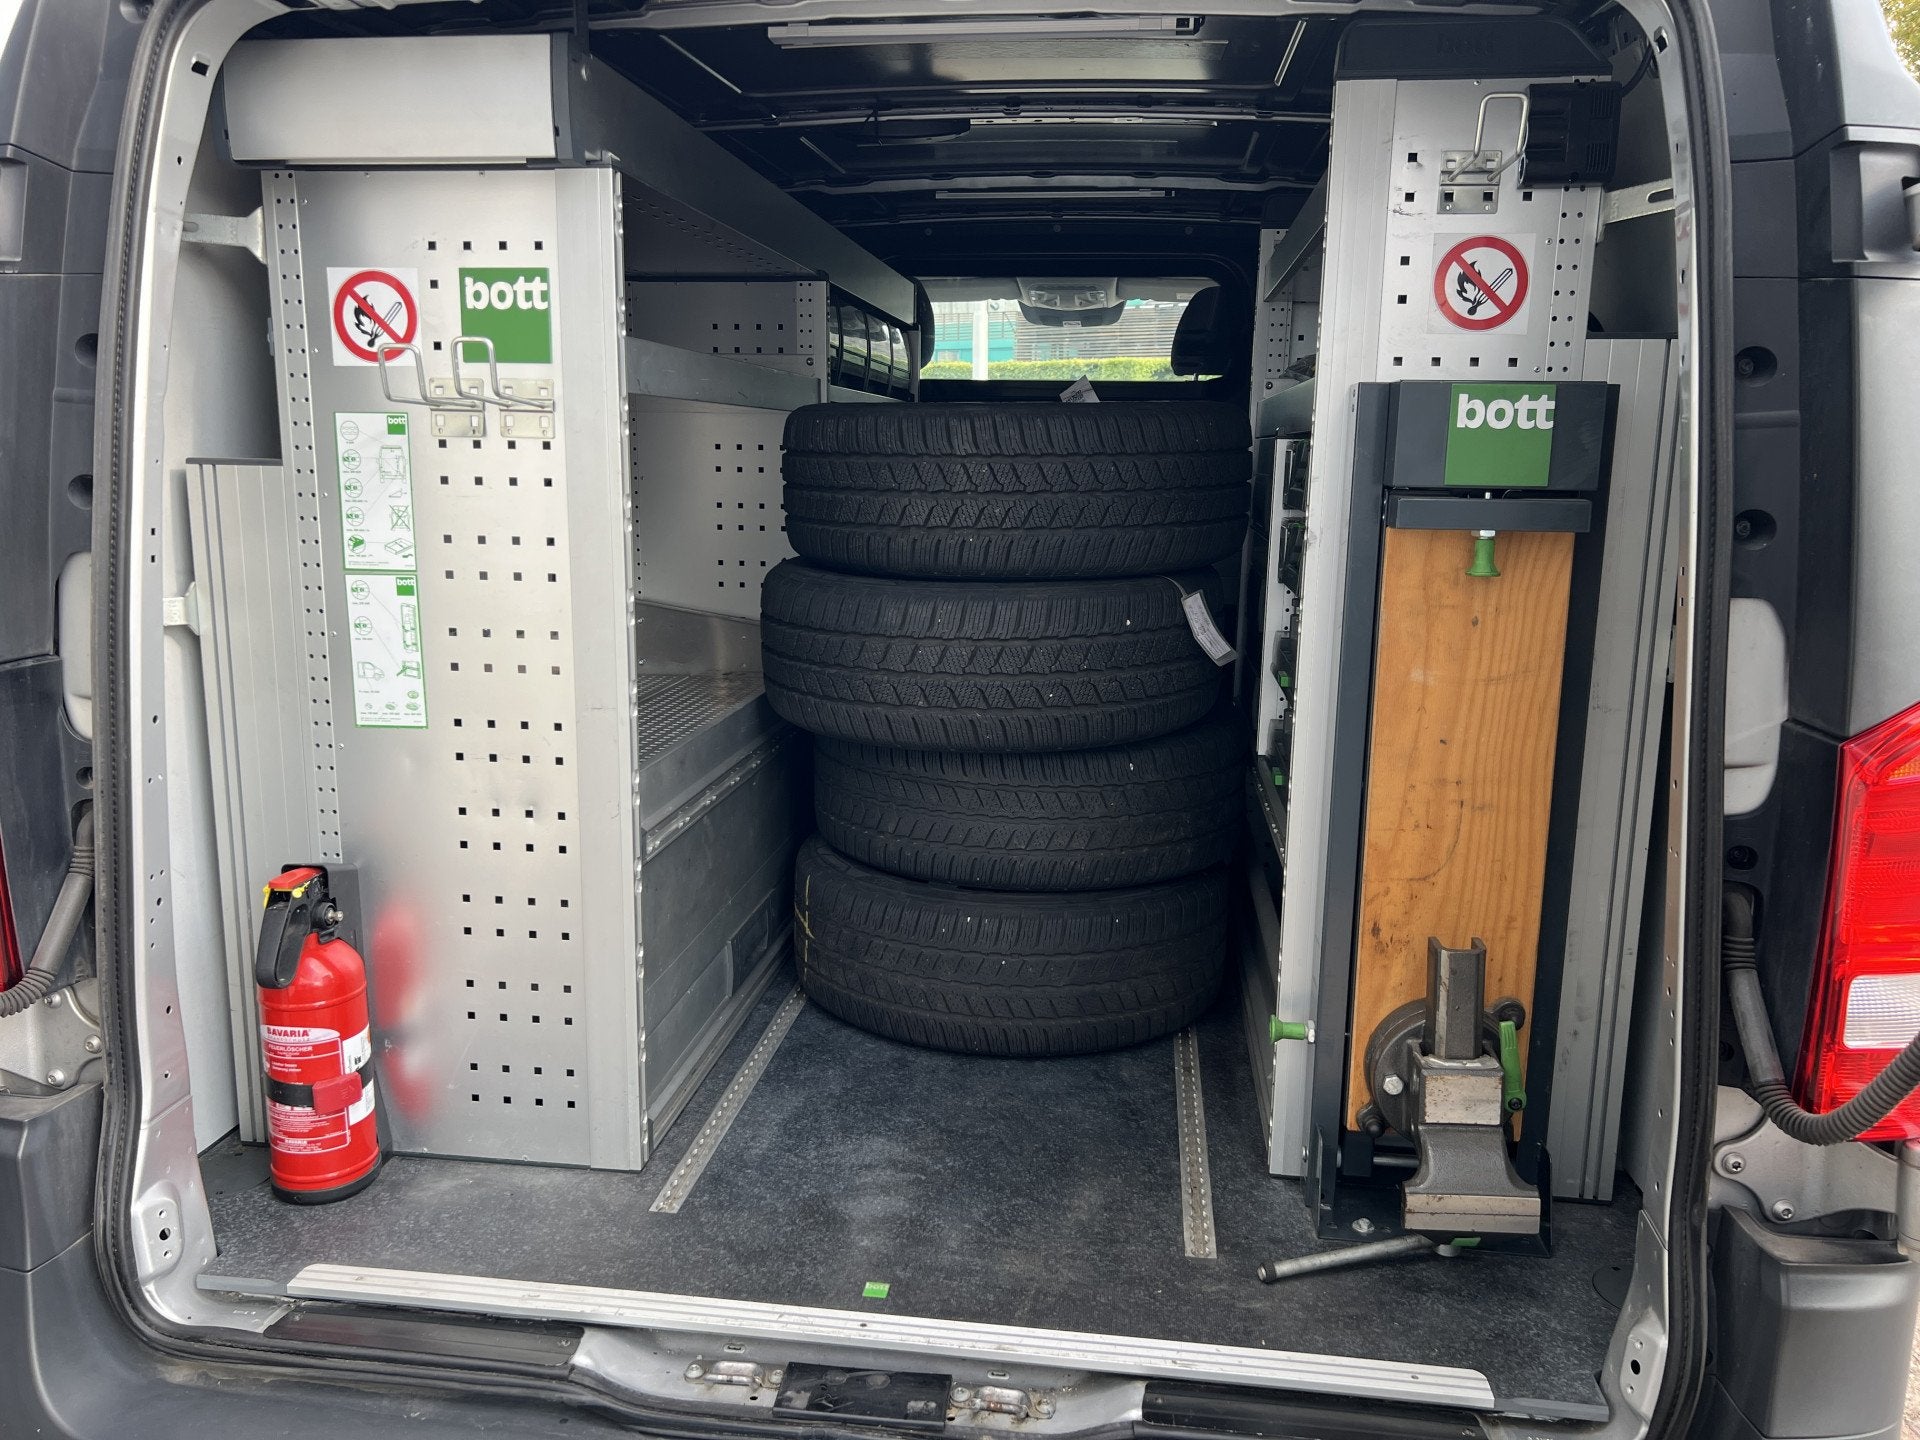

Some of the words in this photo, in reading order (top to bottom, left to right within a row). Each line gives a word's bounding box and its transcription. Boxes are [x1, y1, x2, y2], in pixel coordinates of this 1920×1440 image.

[464, 276, 548, 310] bott
[1456, 393, 1556, 430] bott
[388, 416, 407, 425] bott
[397, 578, 415, 586] bott
[267, 1027, 309, 1037] BAVARIA
[268, 1044, 313, 1052] FEUERLÖSCHER
